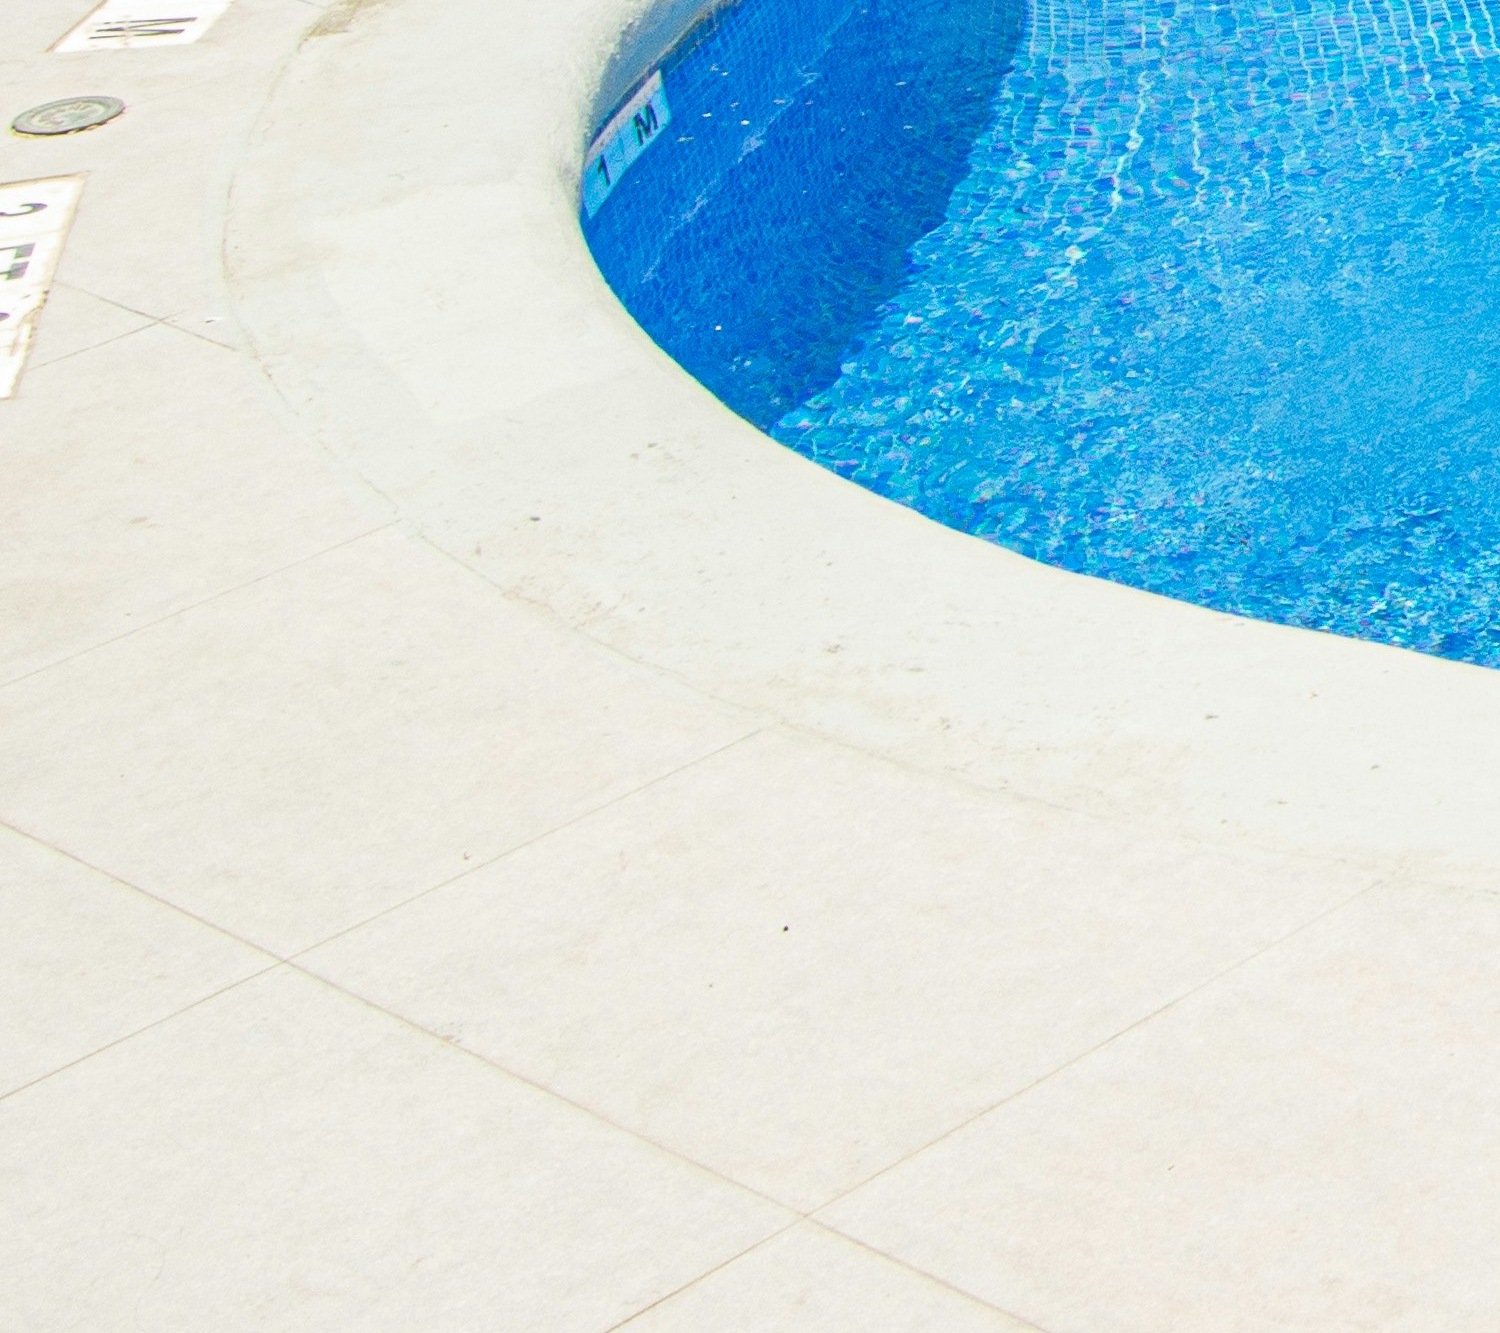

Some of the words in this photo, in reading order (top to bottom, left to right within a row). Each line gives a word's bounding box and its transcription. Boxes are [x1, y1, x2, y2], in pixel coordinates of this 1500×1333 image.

[88, 16, 199, 40] M
[597, 153, 611, 186] 1
[632, 99, 659, 147] M
